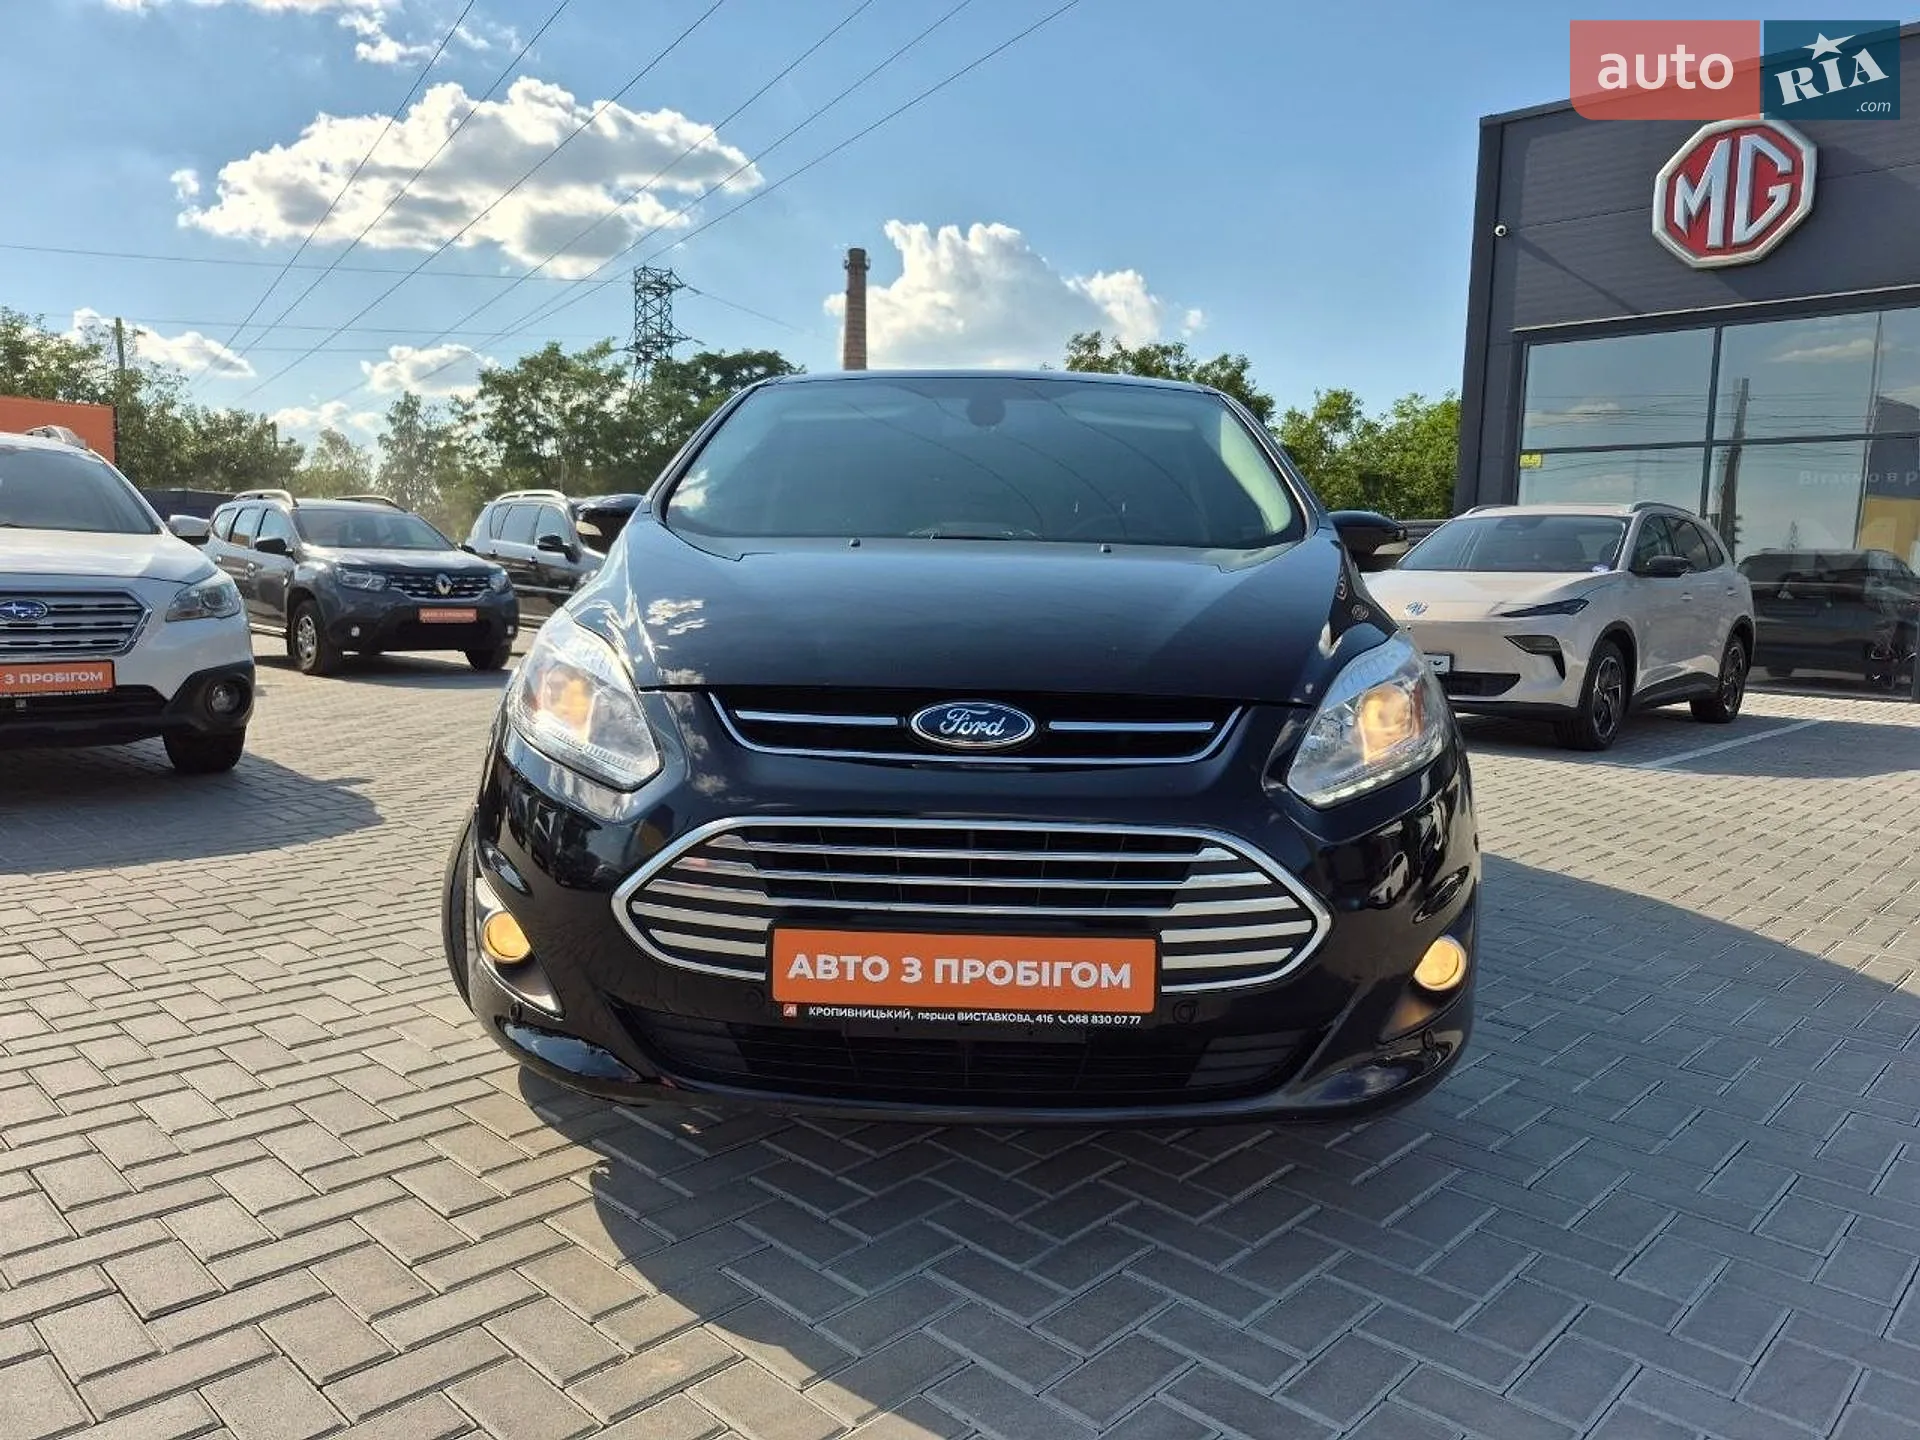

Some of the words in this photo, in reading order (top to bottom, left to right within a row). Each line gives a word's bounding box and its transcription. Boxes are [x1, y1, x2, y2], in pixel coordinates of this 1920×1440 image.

[1674, 134, 1793, 249] MG
[20, 671, 103, 684] ПРОБІГОМ
[940, 708, 1006, 736] Ford
[787, 953, 890, 983] АВТО
[901, 957, 923, 984] З
[934, 957, 1132, 988] ПРОБІГОМ
[808, 1006, 914, 1021] КРОПИВНИЦЬКИЙ,
